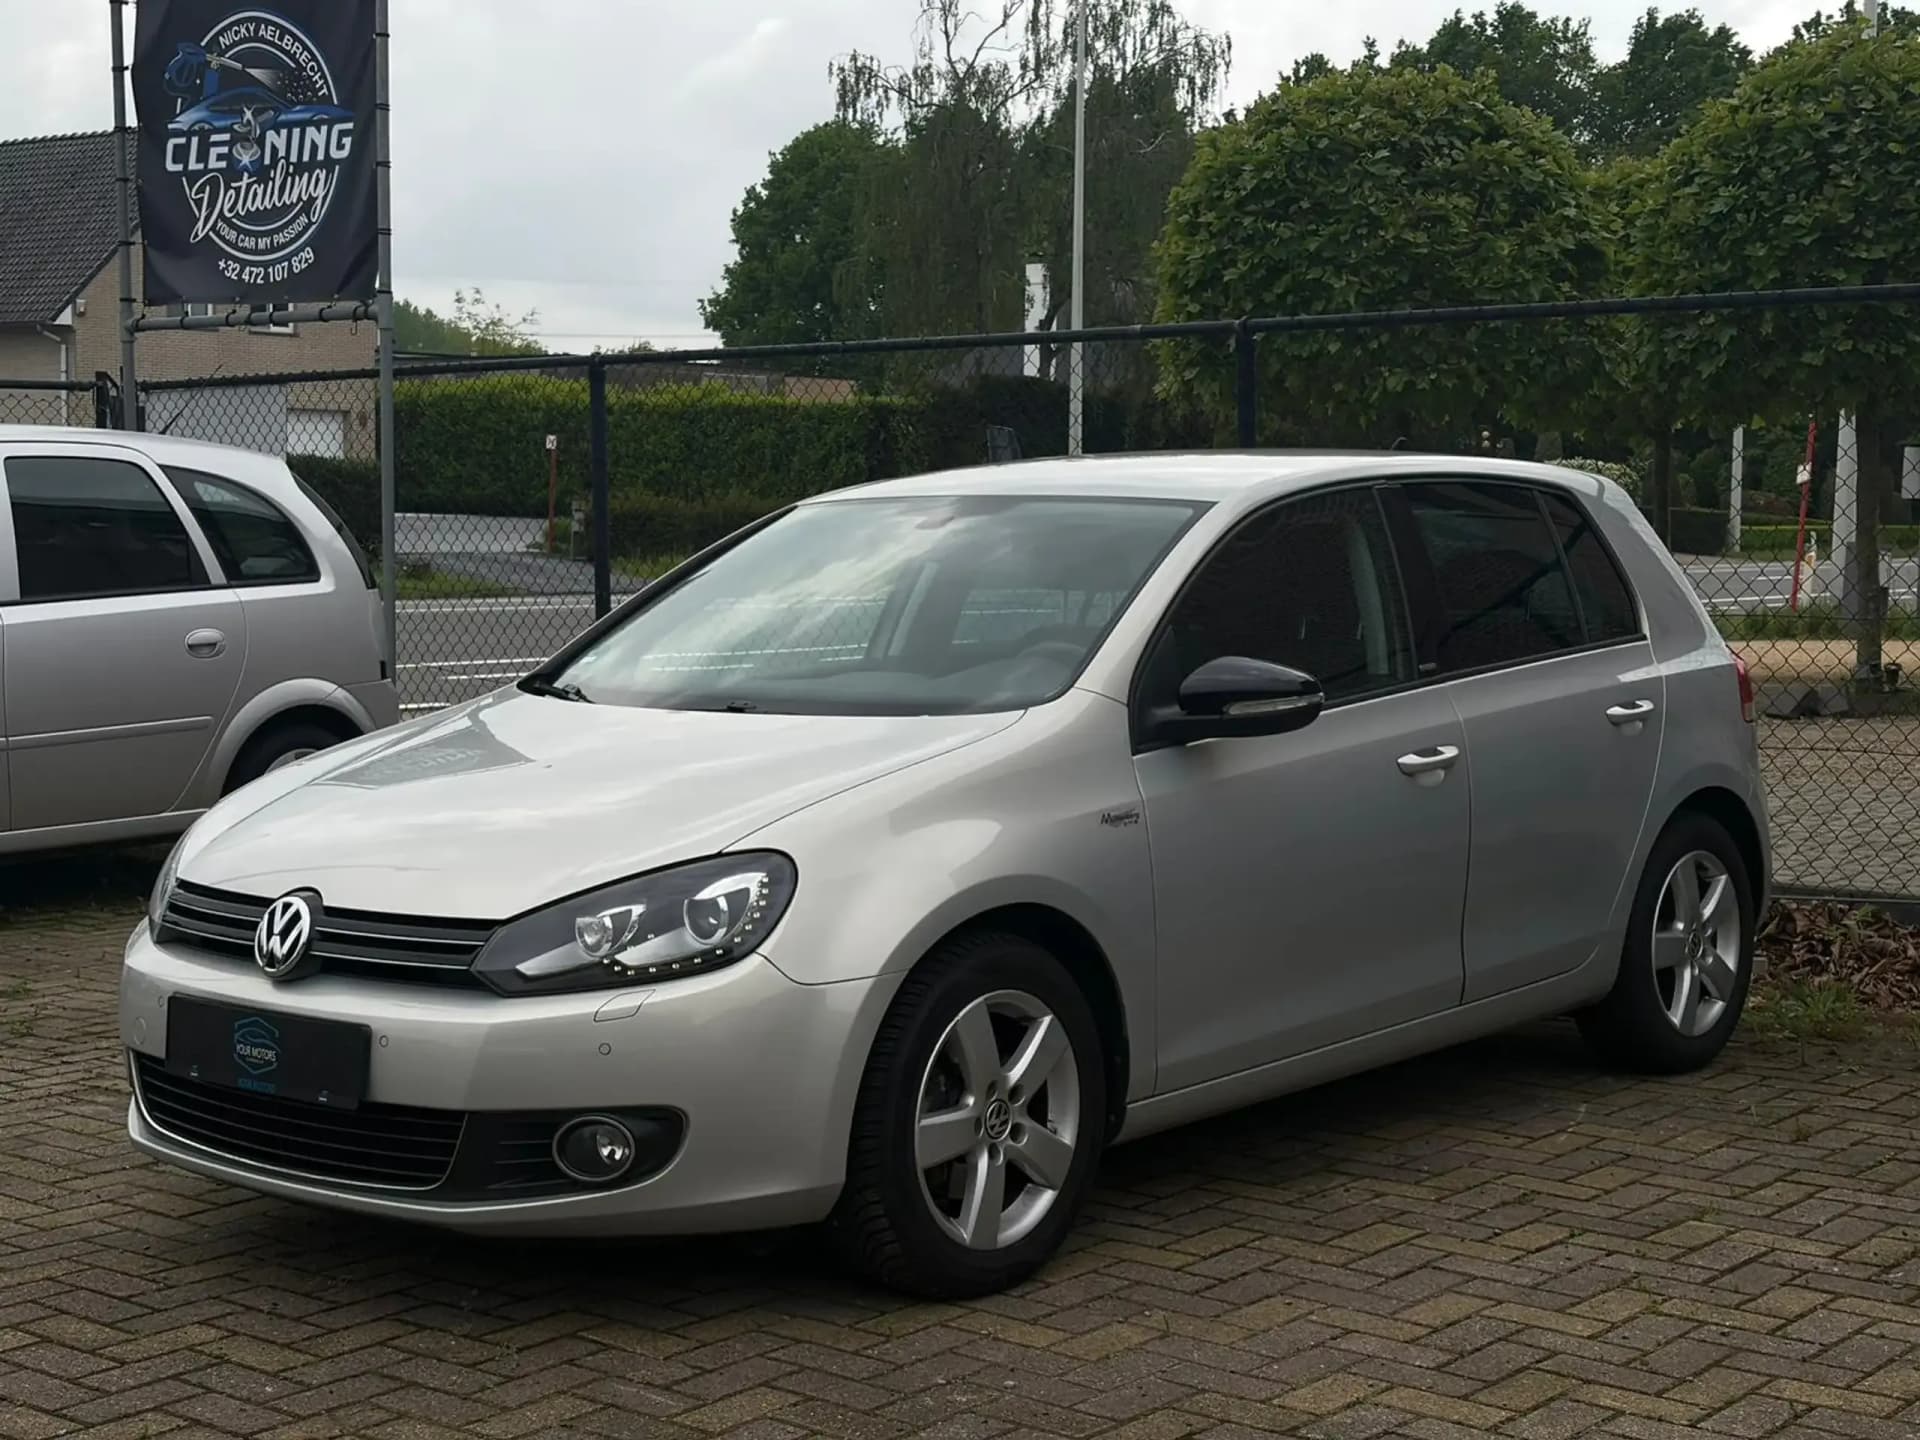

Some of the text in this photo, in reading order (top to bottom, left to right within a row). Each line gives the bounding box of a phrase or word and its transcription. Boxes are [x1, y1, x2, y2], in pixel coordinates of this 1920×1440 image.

[218, 22, 329, 98] NICKY AELBRECHT
[165, 121, 355, 173] CLENING
[190, 158, 331, 244] Detailing
[216, 214, 309, 251] YOUR CAR MY PASSION
[217, 246, 315, 284] +32 472 107 829
